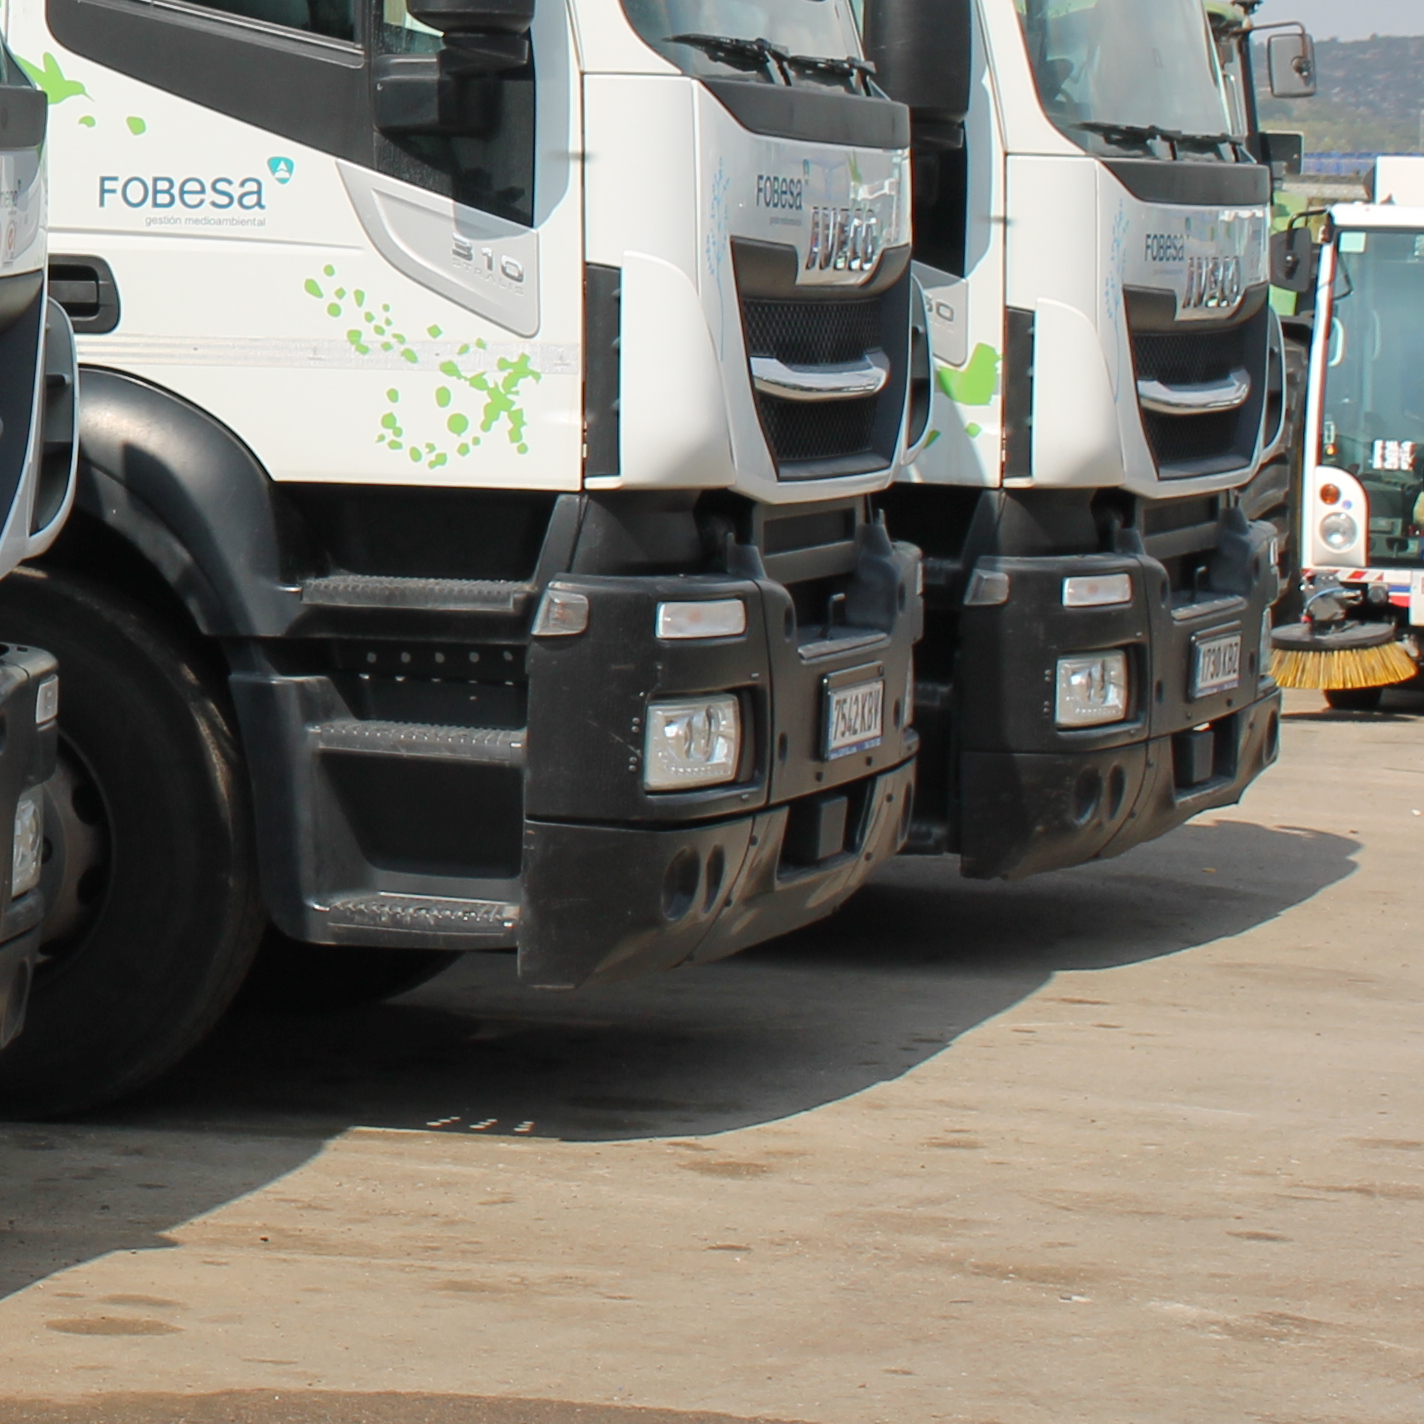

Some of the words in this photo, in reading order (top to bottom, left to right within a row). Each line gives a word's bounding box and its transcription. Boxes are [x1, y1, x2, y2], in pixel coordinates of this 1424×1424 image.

[144, 215, 182, 227] gestión
[184, 216, 266, 227] medioambiental
[452, 232, 524, 284] 310
[834, 694, 859, 741] 7542
